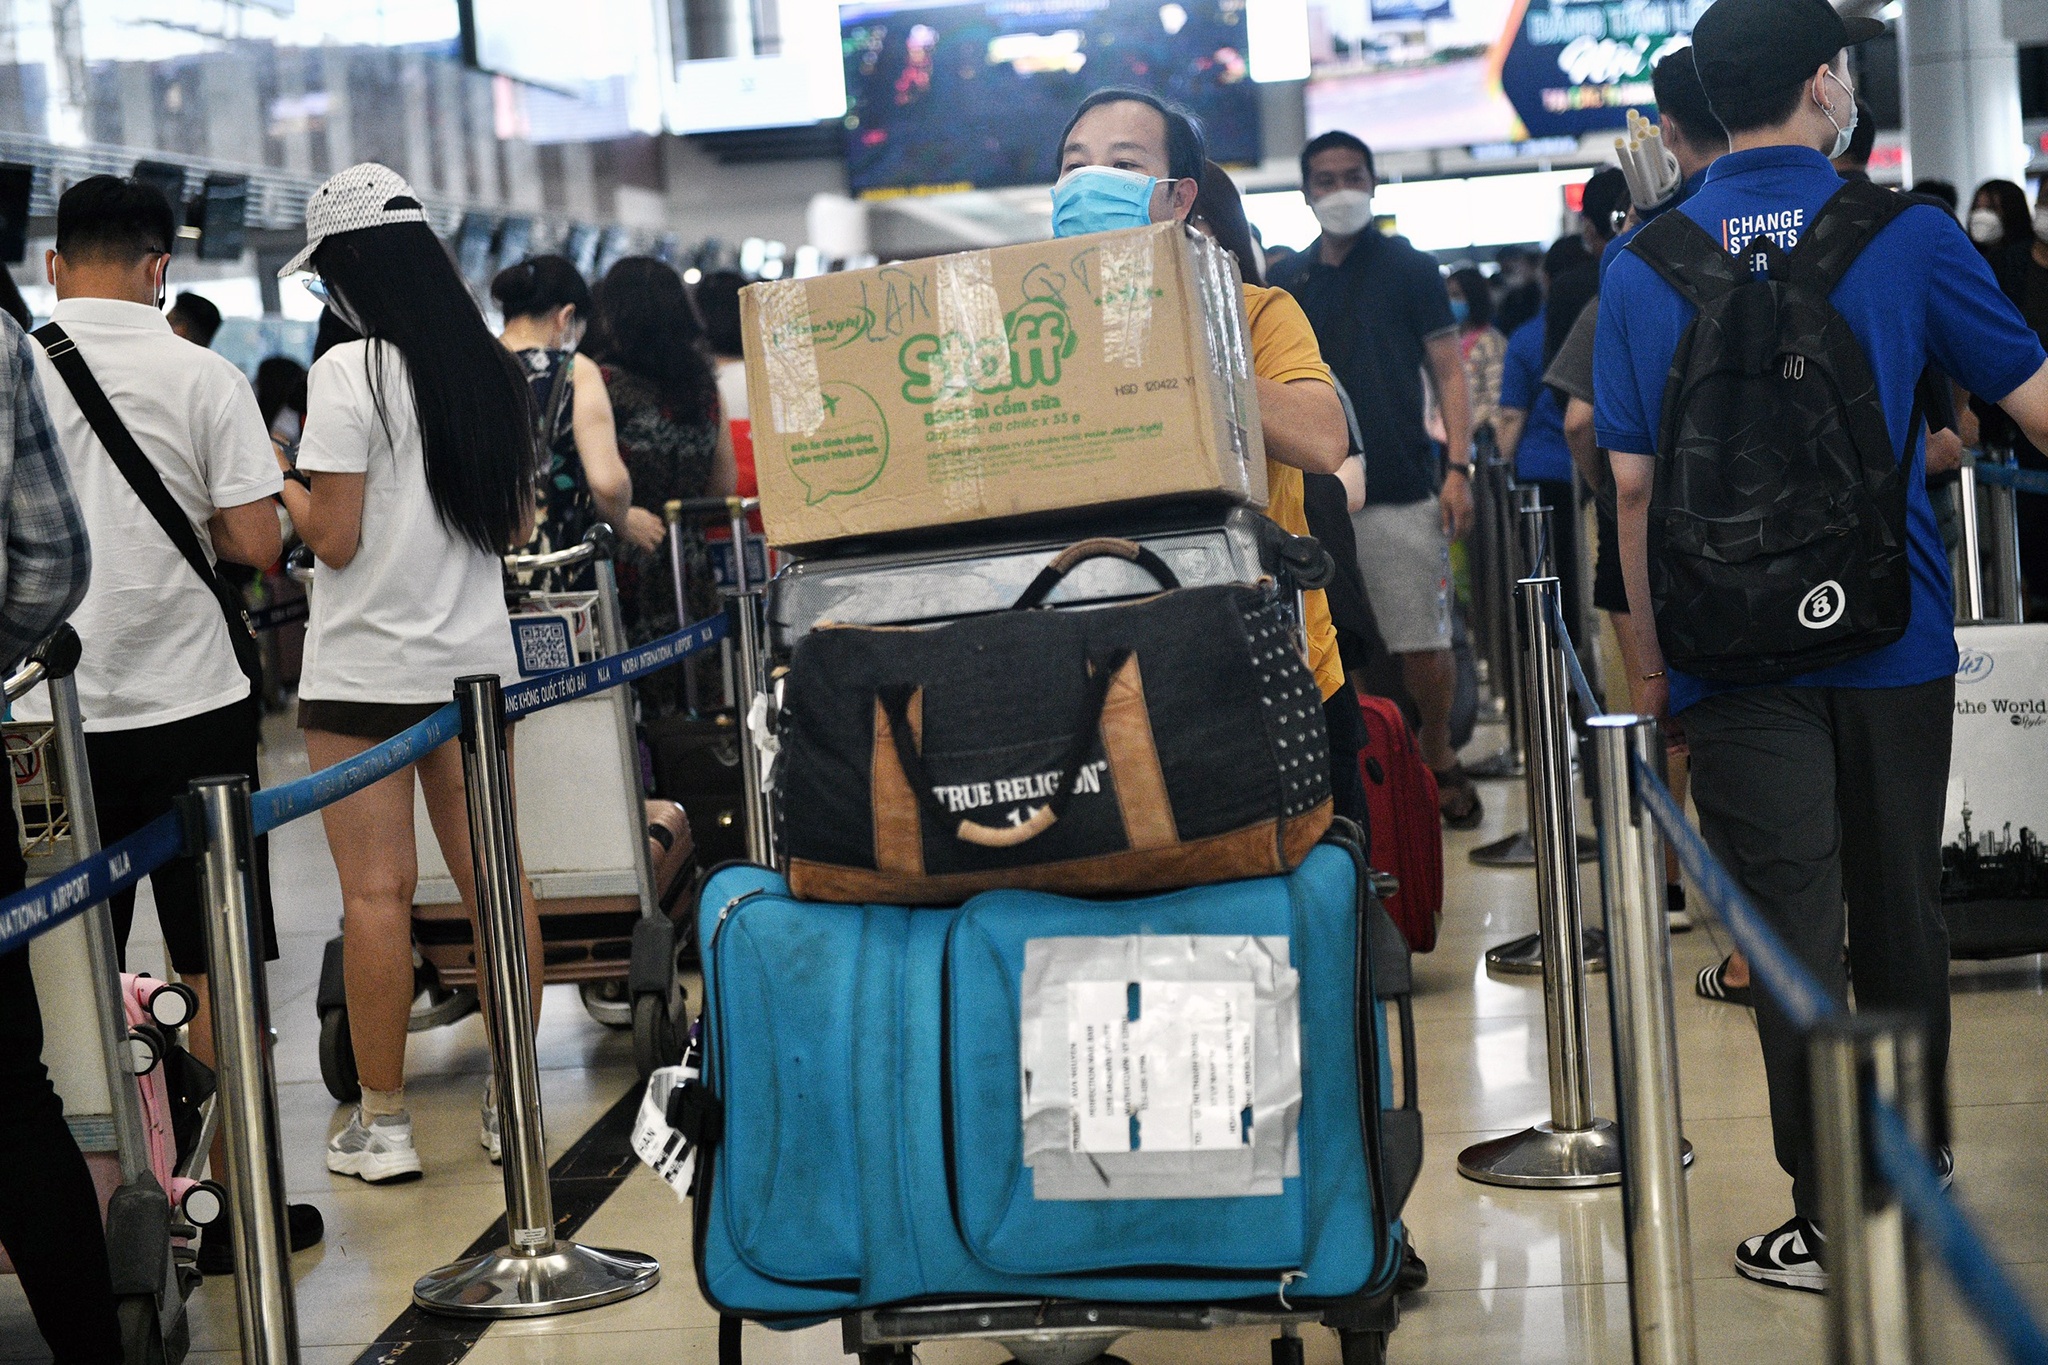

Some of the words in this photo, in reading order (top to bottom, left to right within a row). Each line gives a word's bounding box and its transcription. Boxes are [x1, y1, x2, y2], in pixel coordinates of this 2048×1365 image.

[1729, 208, 1803, 235] CHANGE
[1730, 229, 1798, 254] STRTS
[1115, 383, 1138, 396] HSD
[519, 687, 540, 709] KHÔNG
[541, 679, 558, 703] QUỐC
[558, 675, 566, 697] TẾ
[566, 674, 577, 697] NỘI
[1956, 699, 1987, 714] the
[1992, 698, 2047, 715] World
[932, 782, 993, 813] TRUE
[51, 873, 90, 917] AIRPORT
